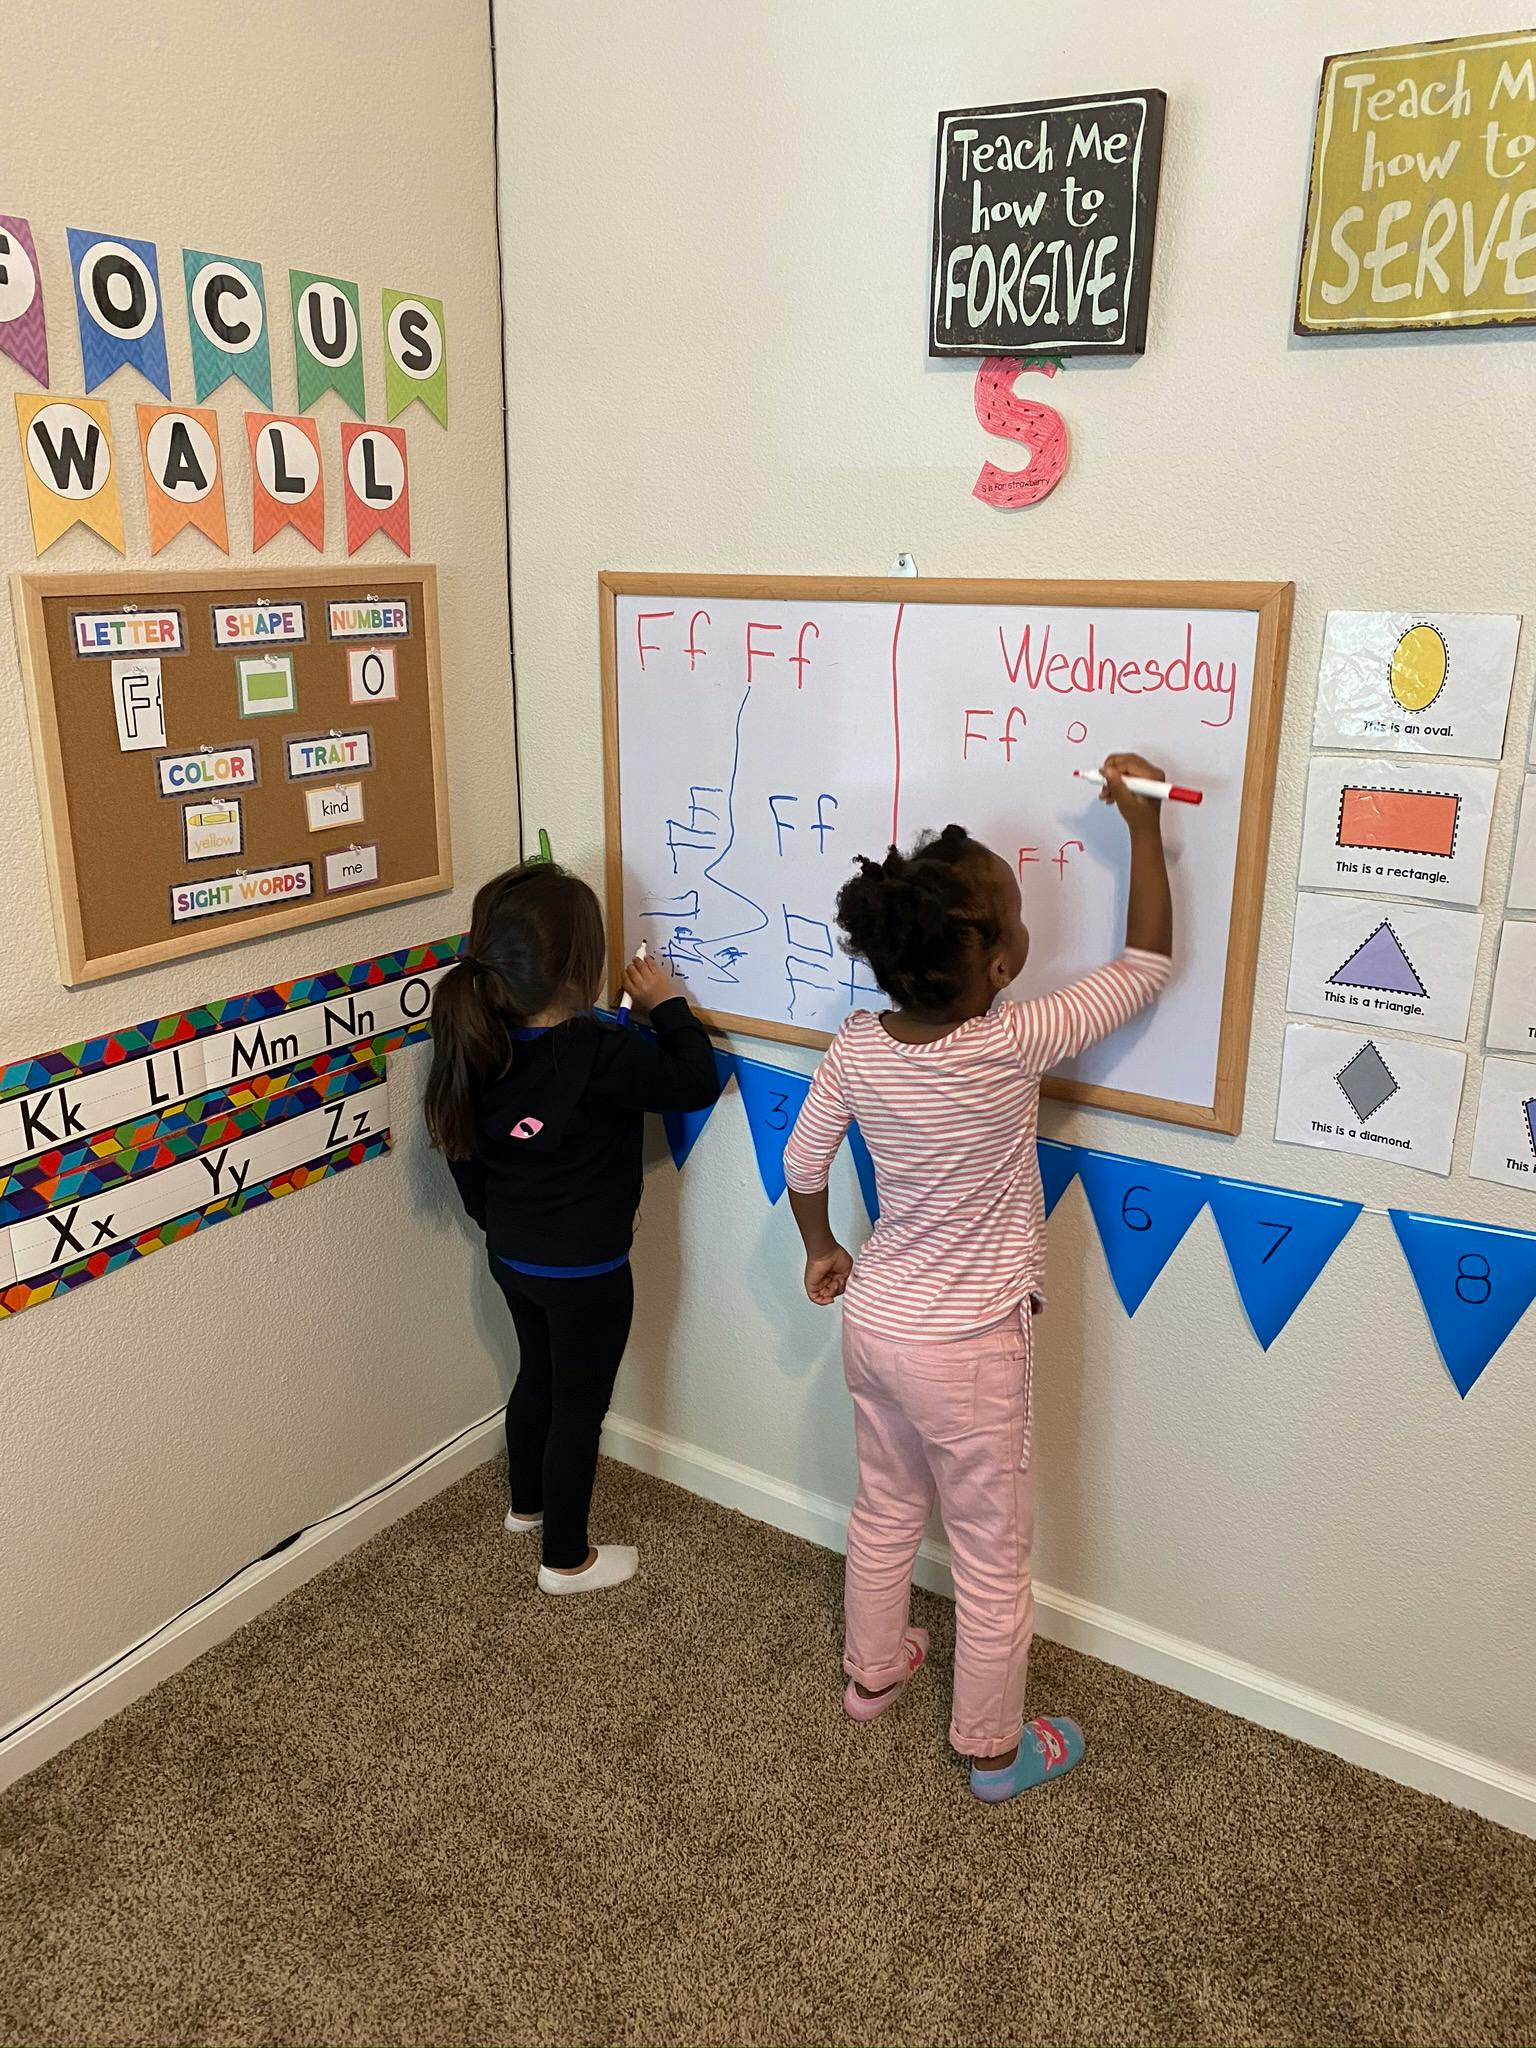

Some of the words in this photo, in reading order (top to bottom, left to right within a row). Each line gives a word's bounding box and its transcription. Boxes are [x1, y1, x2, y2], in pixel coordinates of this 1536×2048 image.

[1343, 59, 1471, 132] Teach
[1488, 58, 1536, 111] M
[953, 120, 1053, 181] Teach
[1066, 121, 1128, 167] Me
[1362, 130, 1461, 192] how
[1480, 120, 1536, 179] to
[971, 179, 1048, 234] how
[1060, 176, 1105, 227] to
[1321, 188, 1536, 304] SERVE
[945, 235, 1119, 329] FORGIVE
[0, 234, 433, 372] OCUS
[33, 421, 393, 501] WALL
[981, 485, 987, 493] S
[80, 619, 175, 647] LETTER
[225, 612, 295, 637] SHAPE
[332, 608, 404, 630] NUMBER
[999, 622, 1237, 727] Wednesday
[121, 674, 164, 738] F
[1390, 722, 1400, 733] is
[1404, 725, 1420, 734] an
[1423, 726, 1454, 737] oval.
[168, 757, 246, 787] COLOR
[301, 741, 357, 768] TRAIT
[321, 796, 349, 816] kind
[193, 832, 234, 853] yellow
[342, 862, 363, 878] me
[1336, 861, 1358, 873] This
[1362, 864, 1373, 875] is
[1375, 867, 1383, 876] a
[1387, 867, 1450, 884] rectangle.
[177, 884, 233, 912] SIGHT
[239, 872, 307, 900] WORDS
[1324, 991, 1346, 1004] This
[1350, 995, 1360, 1006] is
[1362, 998, 1370, 1007] a
[1374, 998, 1425, 1016] triangle.
[20, 1088, 87, 1151] Kk
[146, 1050, 184, 1106] Ll
[231, 1026, 299, 1078] Mm
[323, 997, 375, 1046] Nn
[400, 977, 431, 1019] O
[764, 1091, 788, 1130] 3
[1311, 1121, 1332, 1135] This
[1335, 1125, 1346, 1136] is
[1348, 1128, 1356, 1138] a
[1360, 1130, 1413, 1150] diamond.
[47, 1206, 118, 1264] Xx
[200, 1149, 250, 1206] Yy
[324, 1102, 371, 1148] Zz
[1506, 1158, 1529, 1172] This
[1122, 1185, 1152, 1232] 6
[1257, 1221, 1293, 1265] 7
[1455, 1253, 1491, 1305] 8
